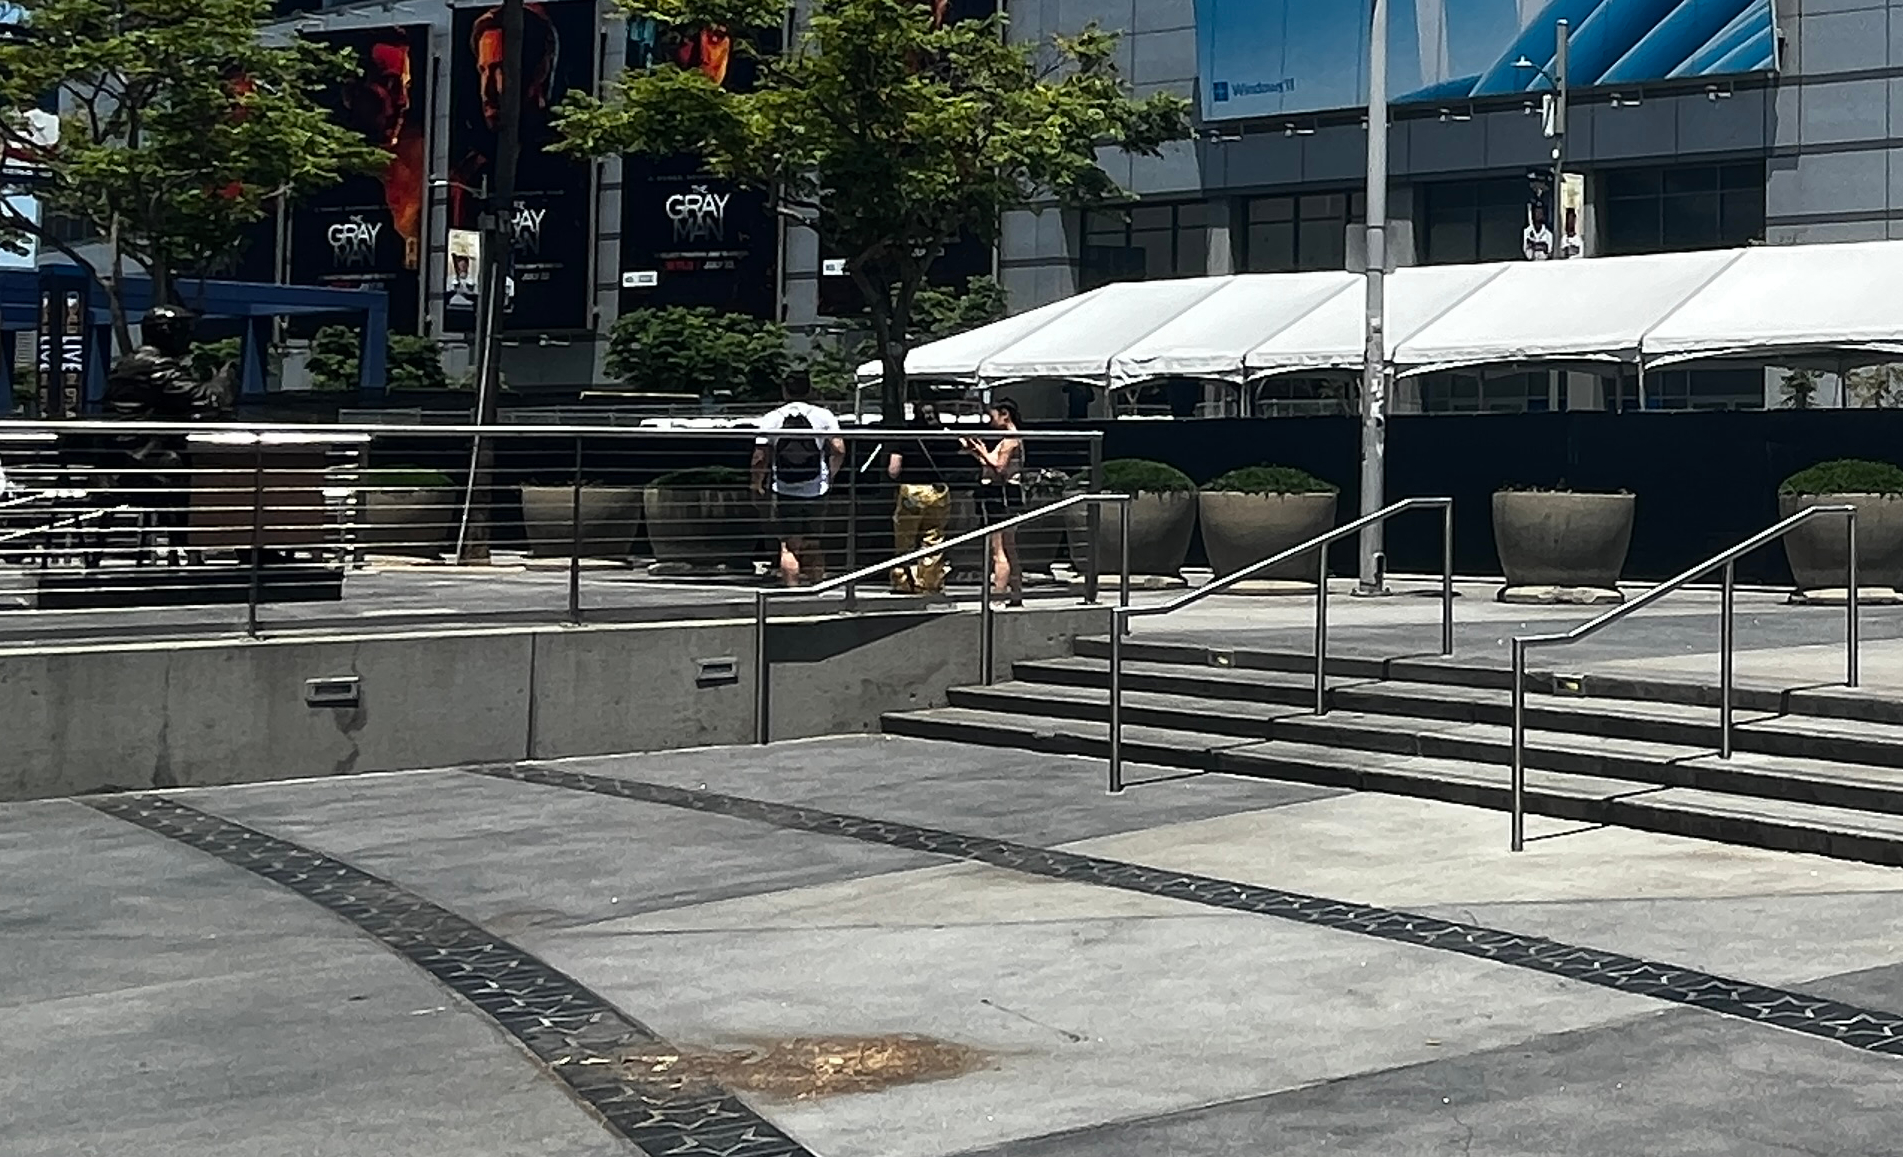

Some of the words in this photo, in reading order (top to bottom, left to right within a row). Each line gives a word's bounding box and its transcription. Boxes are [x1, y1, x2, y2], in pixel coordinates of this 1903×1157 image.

[665, 193, 733, 219] GRAY
[327, 222, 382, 247] GRAY
[673, 216, 725, 243] MAN
[333, 244, 376, 267] MAN
[62, 335, 83, 373] LIVE
